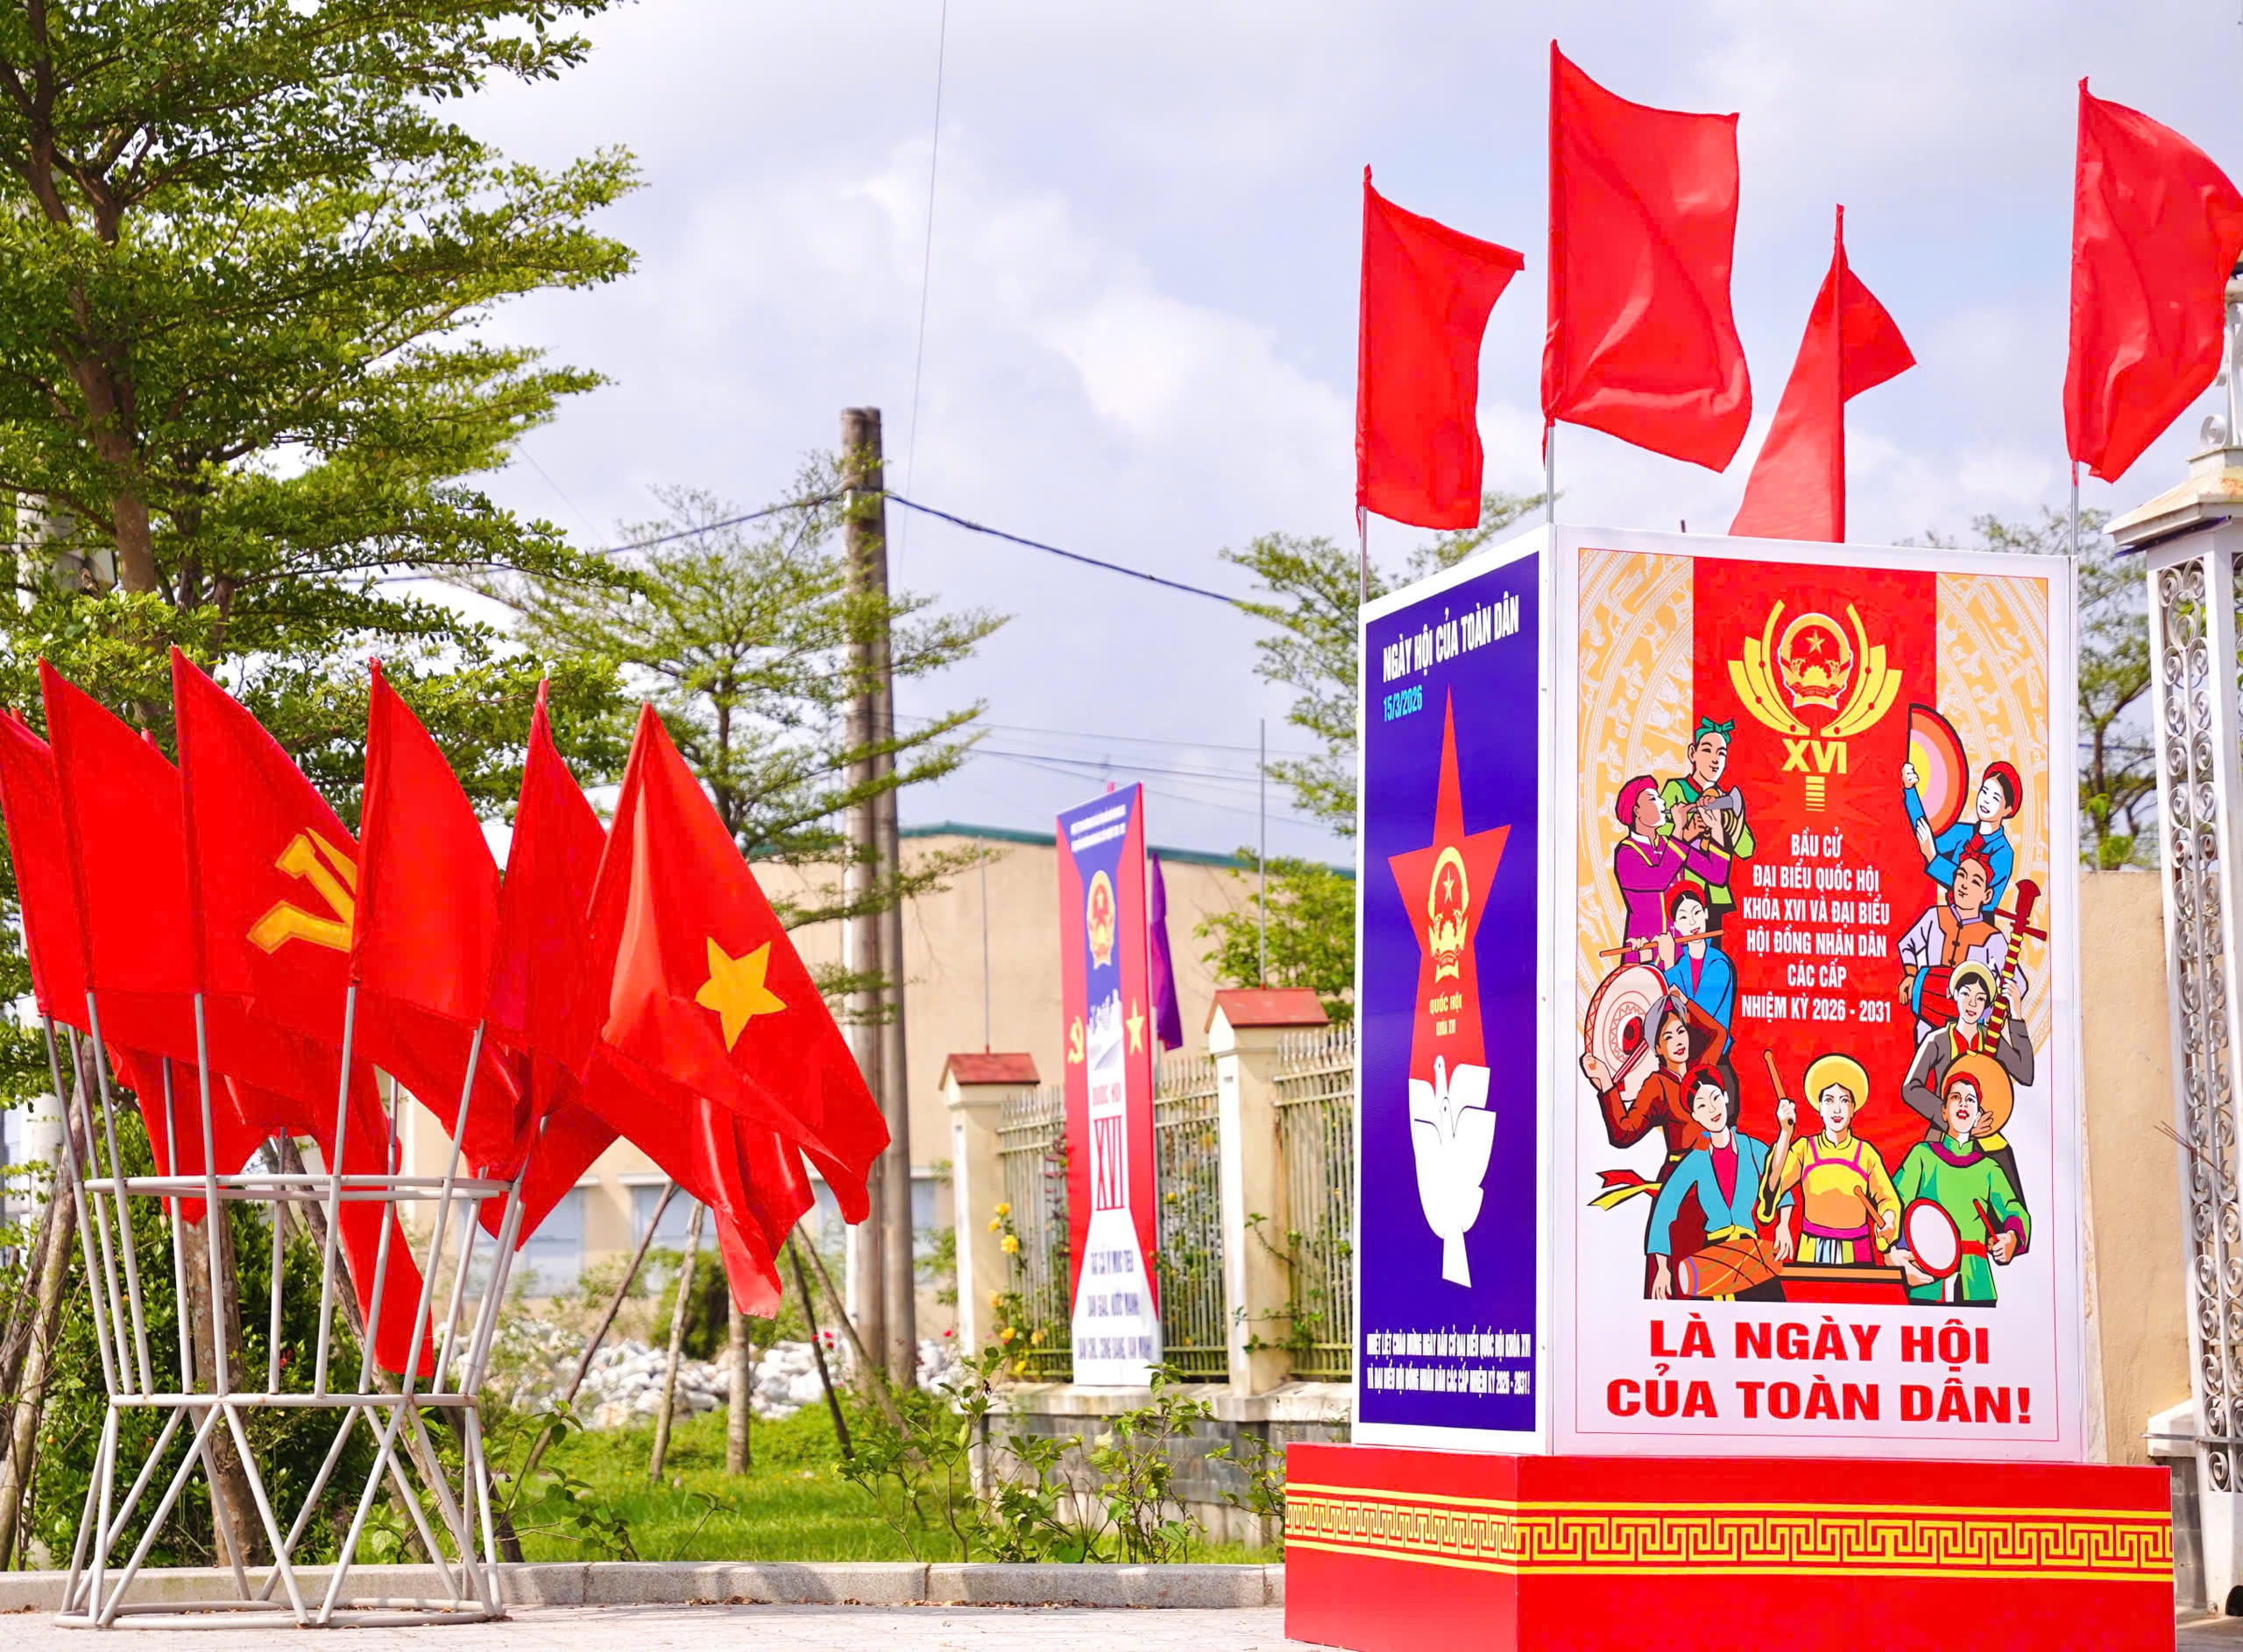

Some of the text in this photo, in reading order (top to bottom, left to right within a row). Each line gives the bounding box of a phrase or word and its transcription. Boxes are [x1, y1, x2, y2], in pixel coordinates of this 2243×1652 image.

[1383, 590, 1519, 683] NGÀY HỘI CỦA TOÀN DÂN
[1383, 684, 1422, 722] 15/3/2026
[1781, 738, 1847, 774] XVI
[1791, 826, 1843, 858] BẦU CỬ
[1752, 858, 1879, 897] ĐẠI BIỂU QUỐC HỘI
[1744, 893, 1890, 928] KHÓA XVI VÀ ĐẠI BIỂU
[1746, 924, 1886, 957] HỘI ĐỒNG NHÂN DÂN
[1787, 958, 1847, 988] CÁC CẤP
[1741, 992, 1787, 1023] NHIỆM
[1791, 993, 1809, 1020] KỲ
[1812, 998, 1845, 1021] 2026
[1859, 1000, 1891, 1022] 2031
[1093, 1114, 1125, 1211] XVI
[1650, 1312, 1989, 1372] LÀ NGÀY HỘI
[1607, 1363, 2031, 1424] CỦA TOÀN DÂN!
